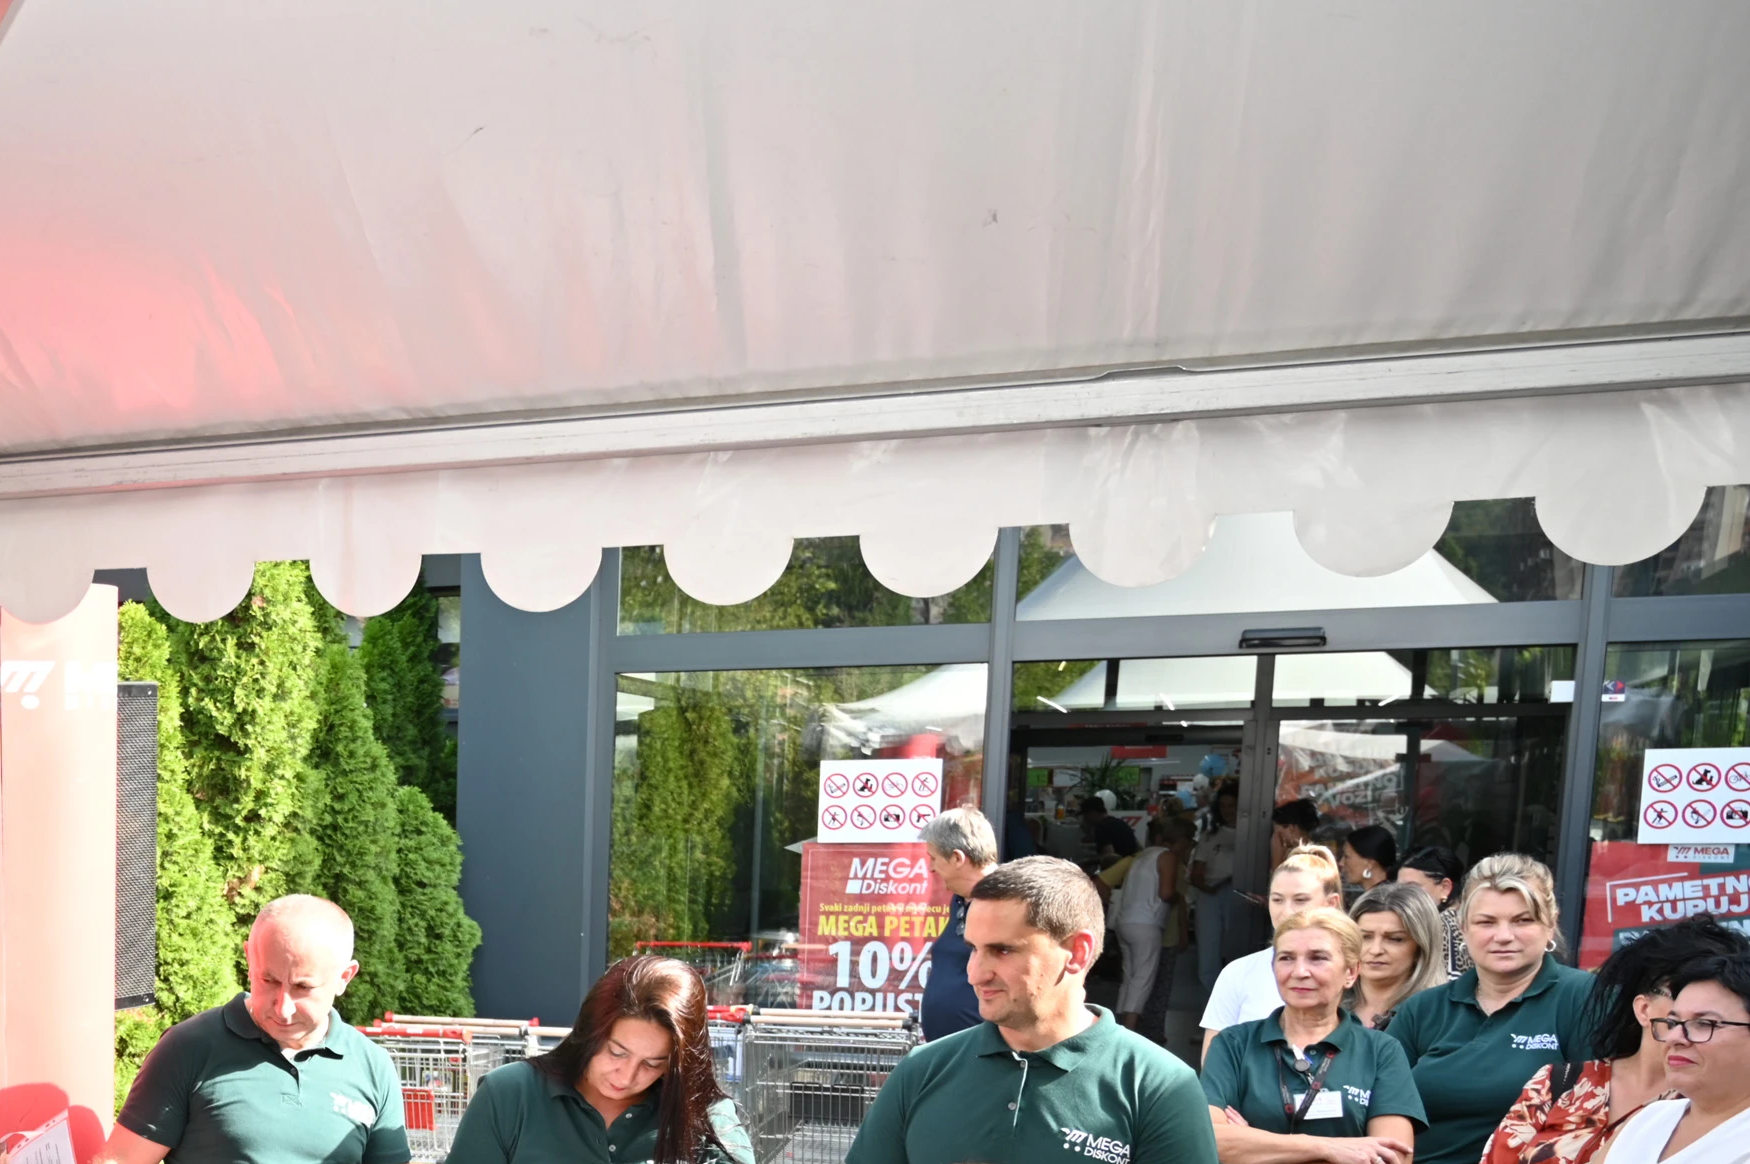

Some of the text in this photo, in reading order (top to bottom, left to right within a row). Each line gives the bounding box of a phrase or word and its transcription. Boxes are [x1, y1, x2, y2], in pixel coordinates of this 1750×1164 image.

[1694, 847, 1729, 856] MEGA
[849, 857, 929, 879] MEGA
[861, 879, 929, 894] Diskont
[1616, 874, 1750, 906] PAMETN
[819, 903, 842, 912] Svaki
[843, 903, 870, 914] zadnji
[1641, 893, 1749, 922] KUPUJ
[817, 915, 879, 937] MEGA
[828, 940, 933, 990] 10%
[1086, 1133, 1130, 1158] MEGA
